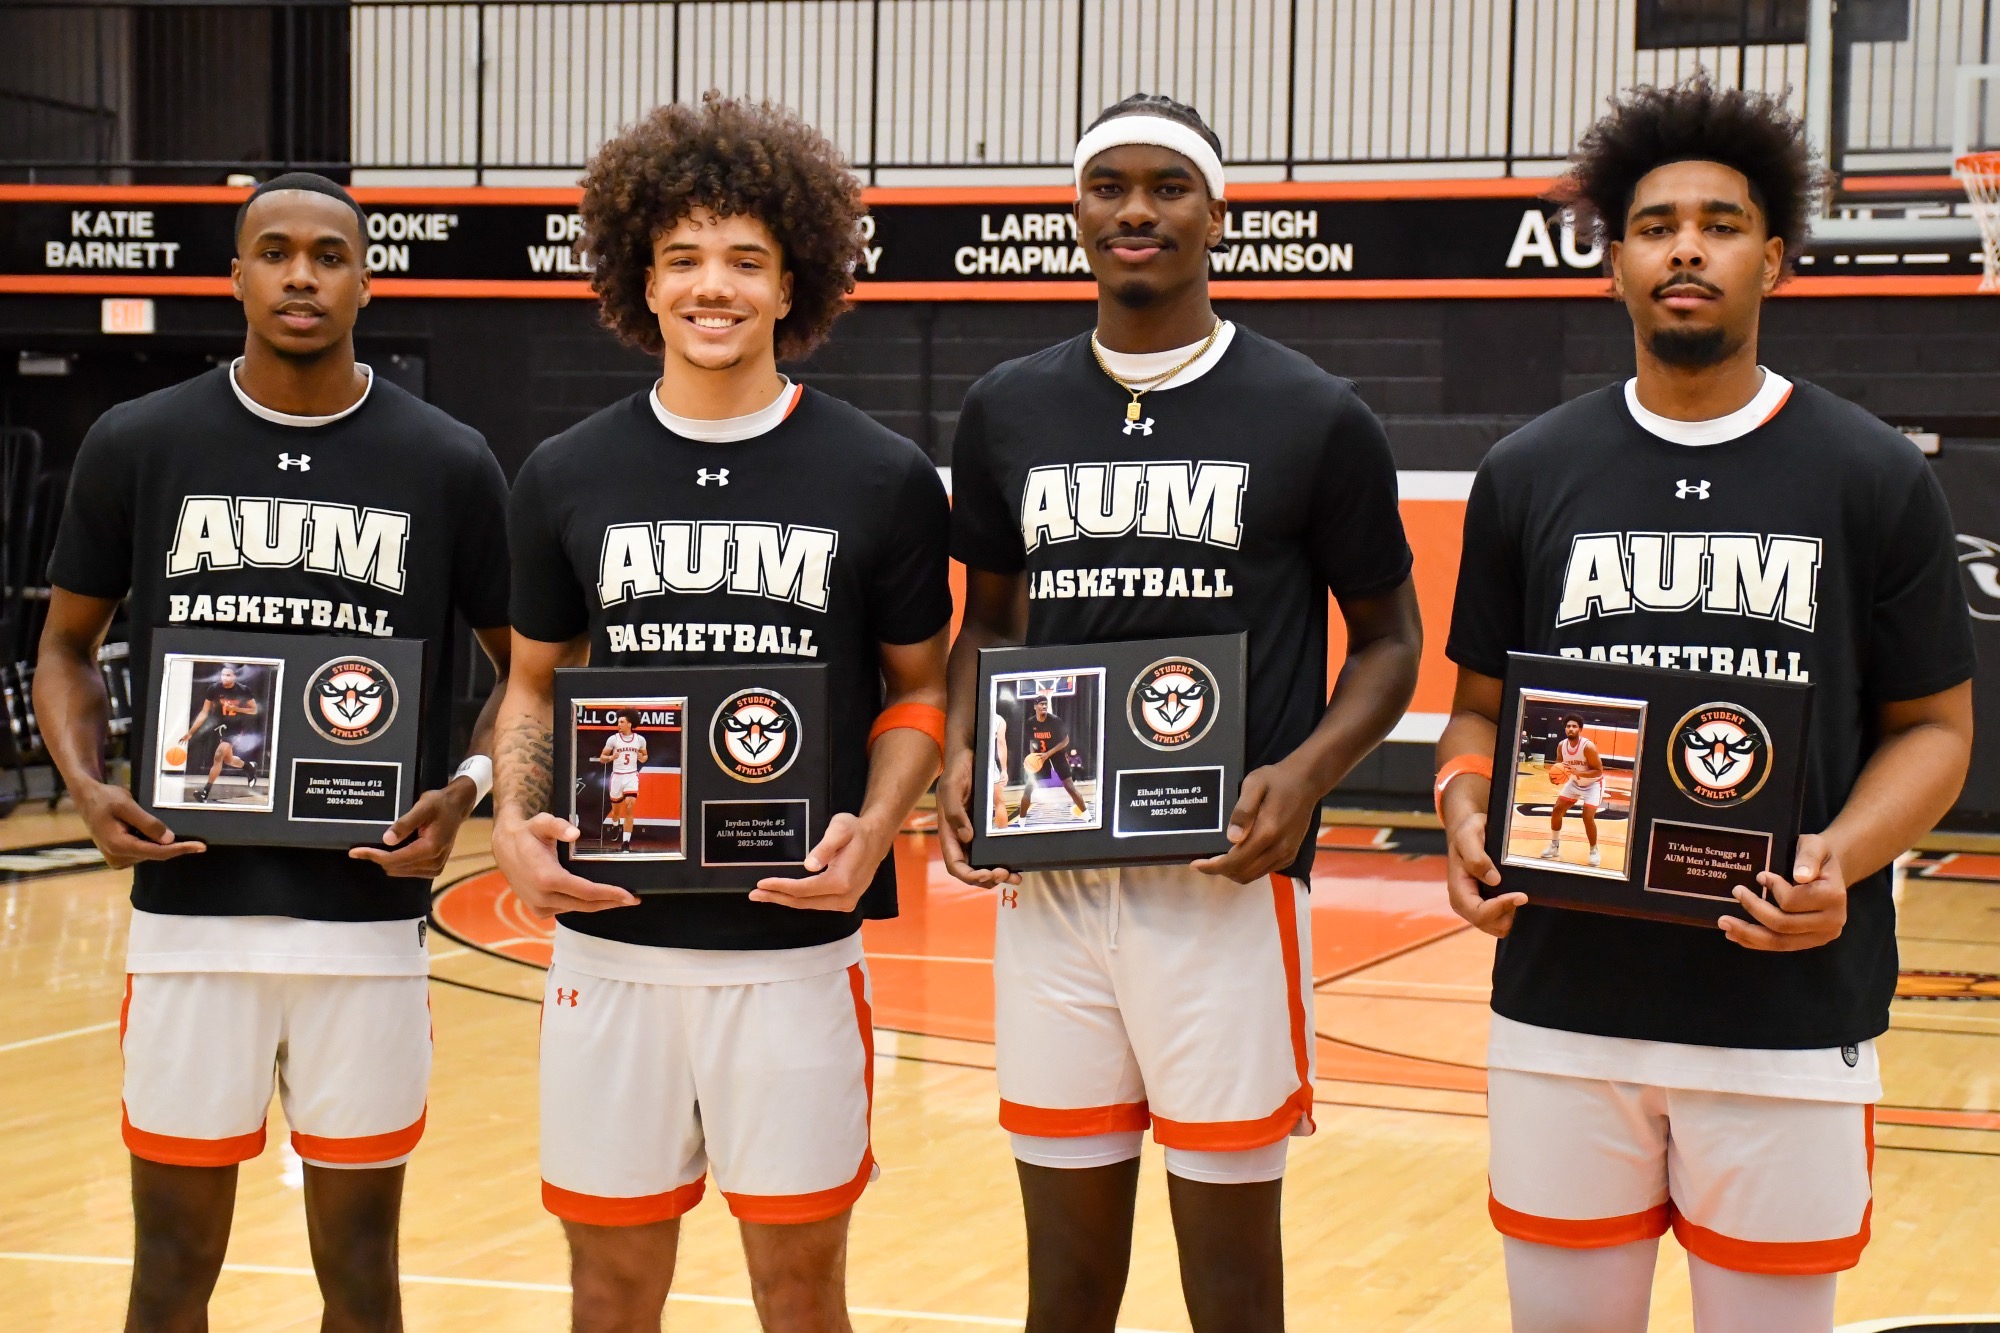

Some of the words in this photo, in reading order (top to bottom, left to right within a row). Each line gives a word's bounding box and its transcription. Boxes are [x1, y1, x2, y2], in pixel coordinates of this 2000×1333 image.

[71, 210, 155, 238] KATIE
[367, 212, 459, 241] OOKIE"
[1224, 210, 1318, 239] LEIGH
[1505, 209, 1604, 269] AU
[45, 241, 180, 269] BARNETT
[366, 244, 410, 272] ON
[527, 245, 597, 273] WILL
[954, 245, 1092, 274] CHAPMA
[1208, 243, 1353, 273] WANSON
[1020, 460, 1250, 556] AUM
[166, 495, 411, 596] AUM
[597, 520, 839, 613] AUM
[1555, 531, 1823, 633] AUM
[168, 594, 394, 637] BASKETBALL
[606, 623, 818, 657] BASKETBALL
[332, 663, 373, 675] STUDENT
[1153, 665, 1194, 678] STUDENT
[736, 696, 777, 708] STUDENT
[638, 711, 675, 725] AME
[1700, 711, 1746, 725] STUDENT
[330, 727, 370, 738] ATHLETE
[1152, 731, 1191, 744] ATHLETE
[623, 753, 631, 766] 5
[735, 764, 774, 776] ATHLETE
[309, 777, 331, 786] Jamir
[332, 778, 366, 787] Williams
[325, 788, 347, 796] Men's
[348, 789, 385, 797] Basketball
[1137, 788, 1164, 797] Elhadji
[1165, 787, 1190, 795] Thiam
[1191, 786, 1201, 794] #3
[1693, 785, 1738, 799] ATHLETE
[327, 797, 364, 805] 2024-2026
[1130, 799, 1148, 807] AUM
[1149, 798, 1171, 806] Men's
[1172, 796, 1208, 805] Basketball
[1151, 807, 1187, 816] 2025-2026
[725, 819, 750, 828] Jayden
[752, 819, 774, 828] Doyle
[758, 829, 794, 837] Basketball
[737, 839, 774, 847] 2025-2026
[1668, 842, 1703, 854] Ti'Avian
[1705, 846, 1737, 860] Scruggs
[1664, 853, 1685, 863] AUM
[1686, 856, 1710, 866] Men's
[1711, 859, 1752, 872] Basketball
[1687, 867, 1728, 879] 2025-2026
